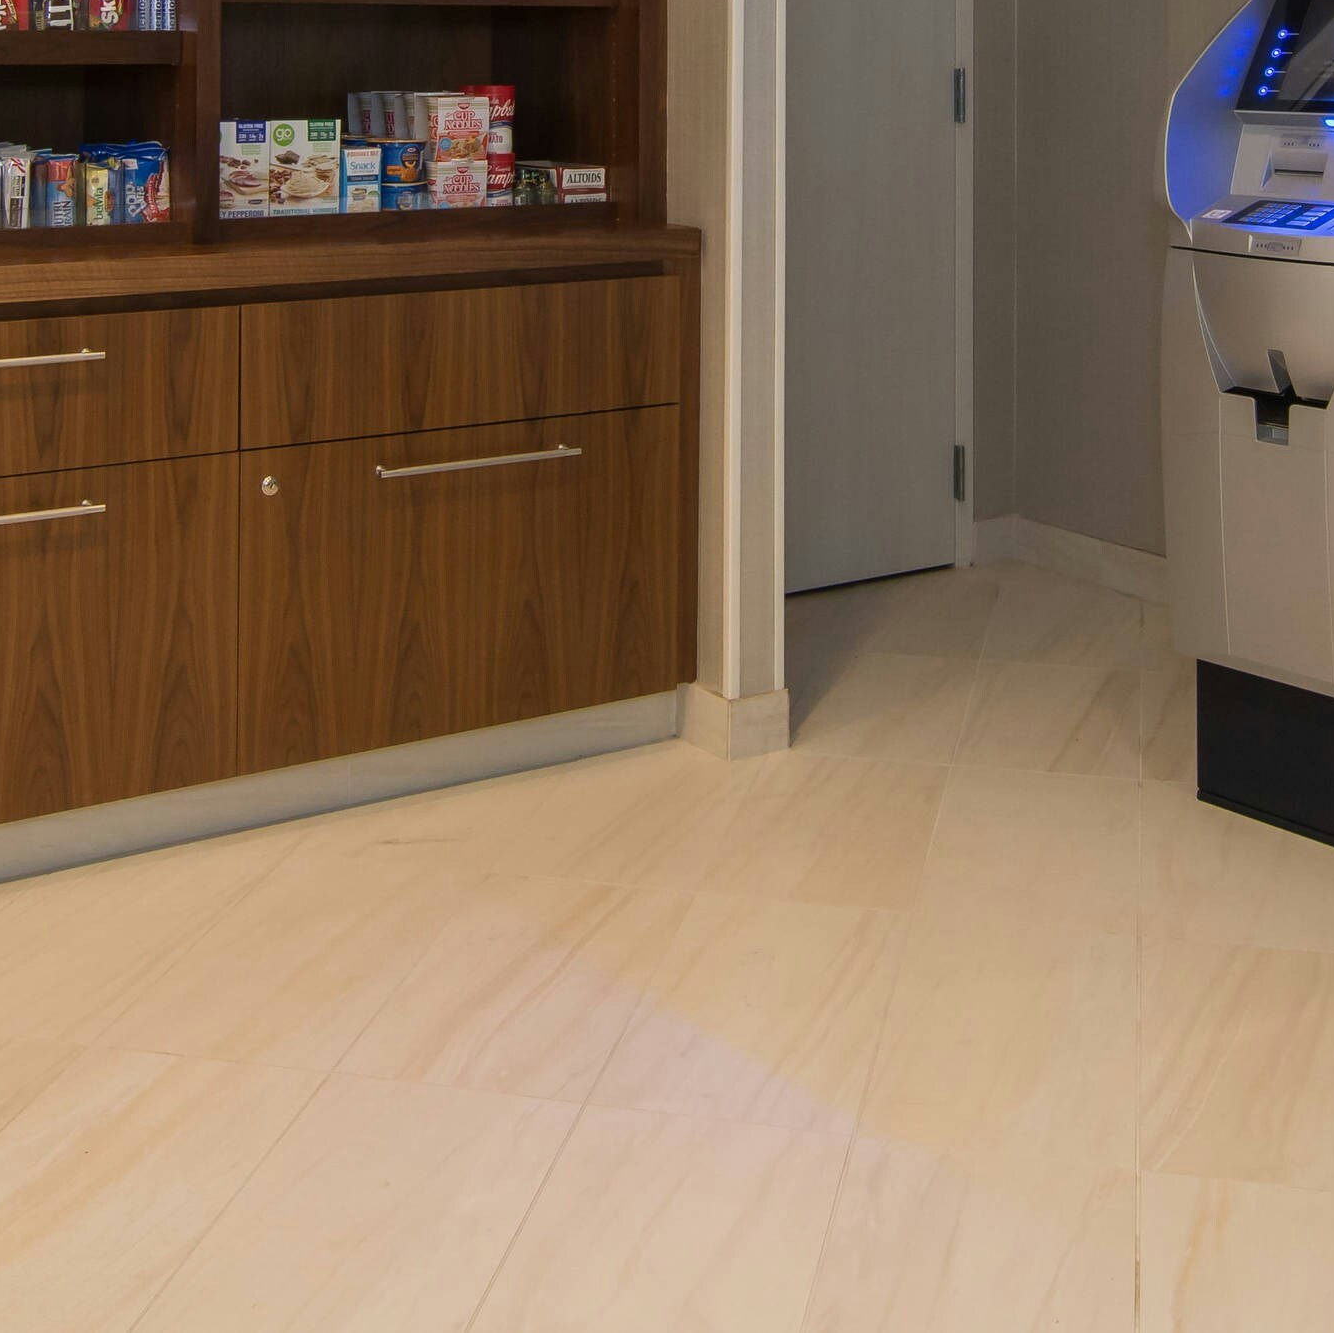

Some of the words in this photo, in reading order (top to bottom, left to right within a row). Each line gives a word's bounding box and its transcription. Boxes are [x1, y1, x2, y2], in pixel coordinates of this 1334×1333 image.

[454, 111, 475, 120] CUP
[444, 119, 482, 130] NOODLES
[275, 128, 292, 141] go
[350, 161, 376, 171] Snack
[452, 175, 473, 184] CUP
[567, 172, 602, 184] ALTOIDS
[443, 183, 480, 194] NOODLES
[92, 187, 106, 220] belVita
[52, 201, 61, 226] UTRI
